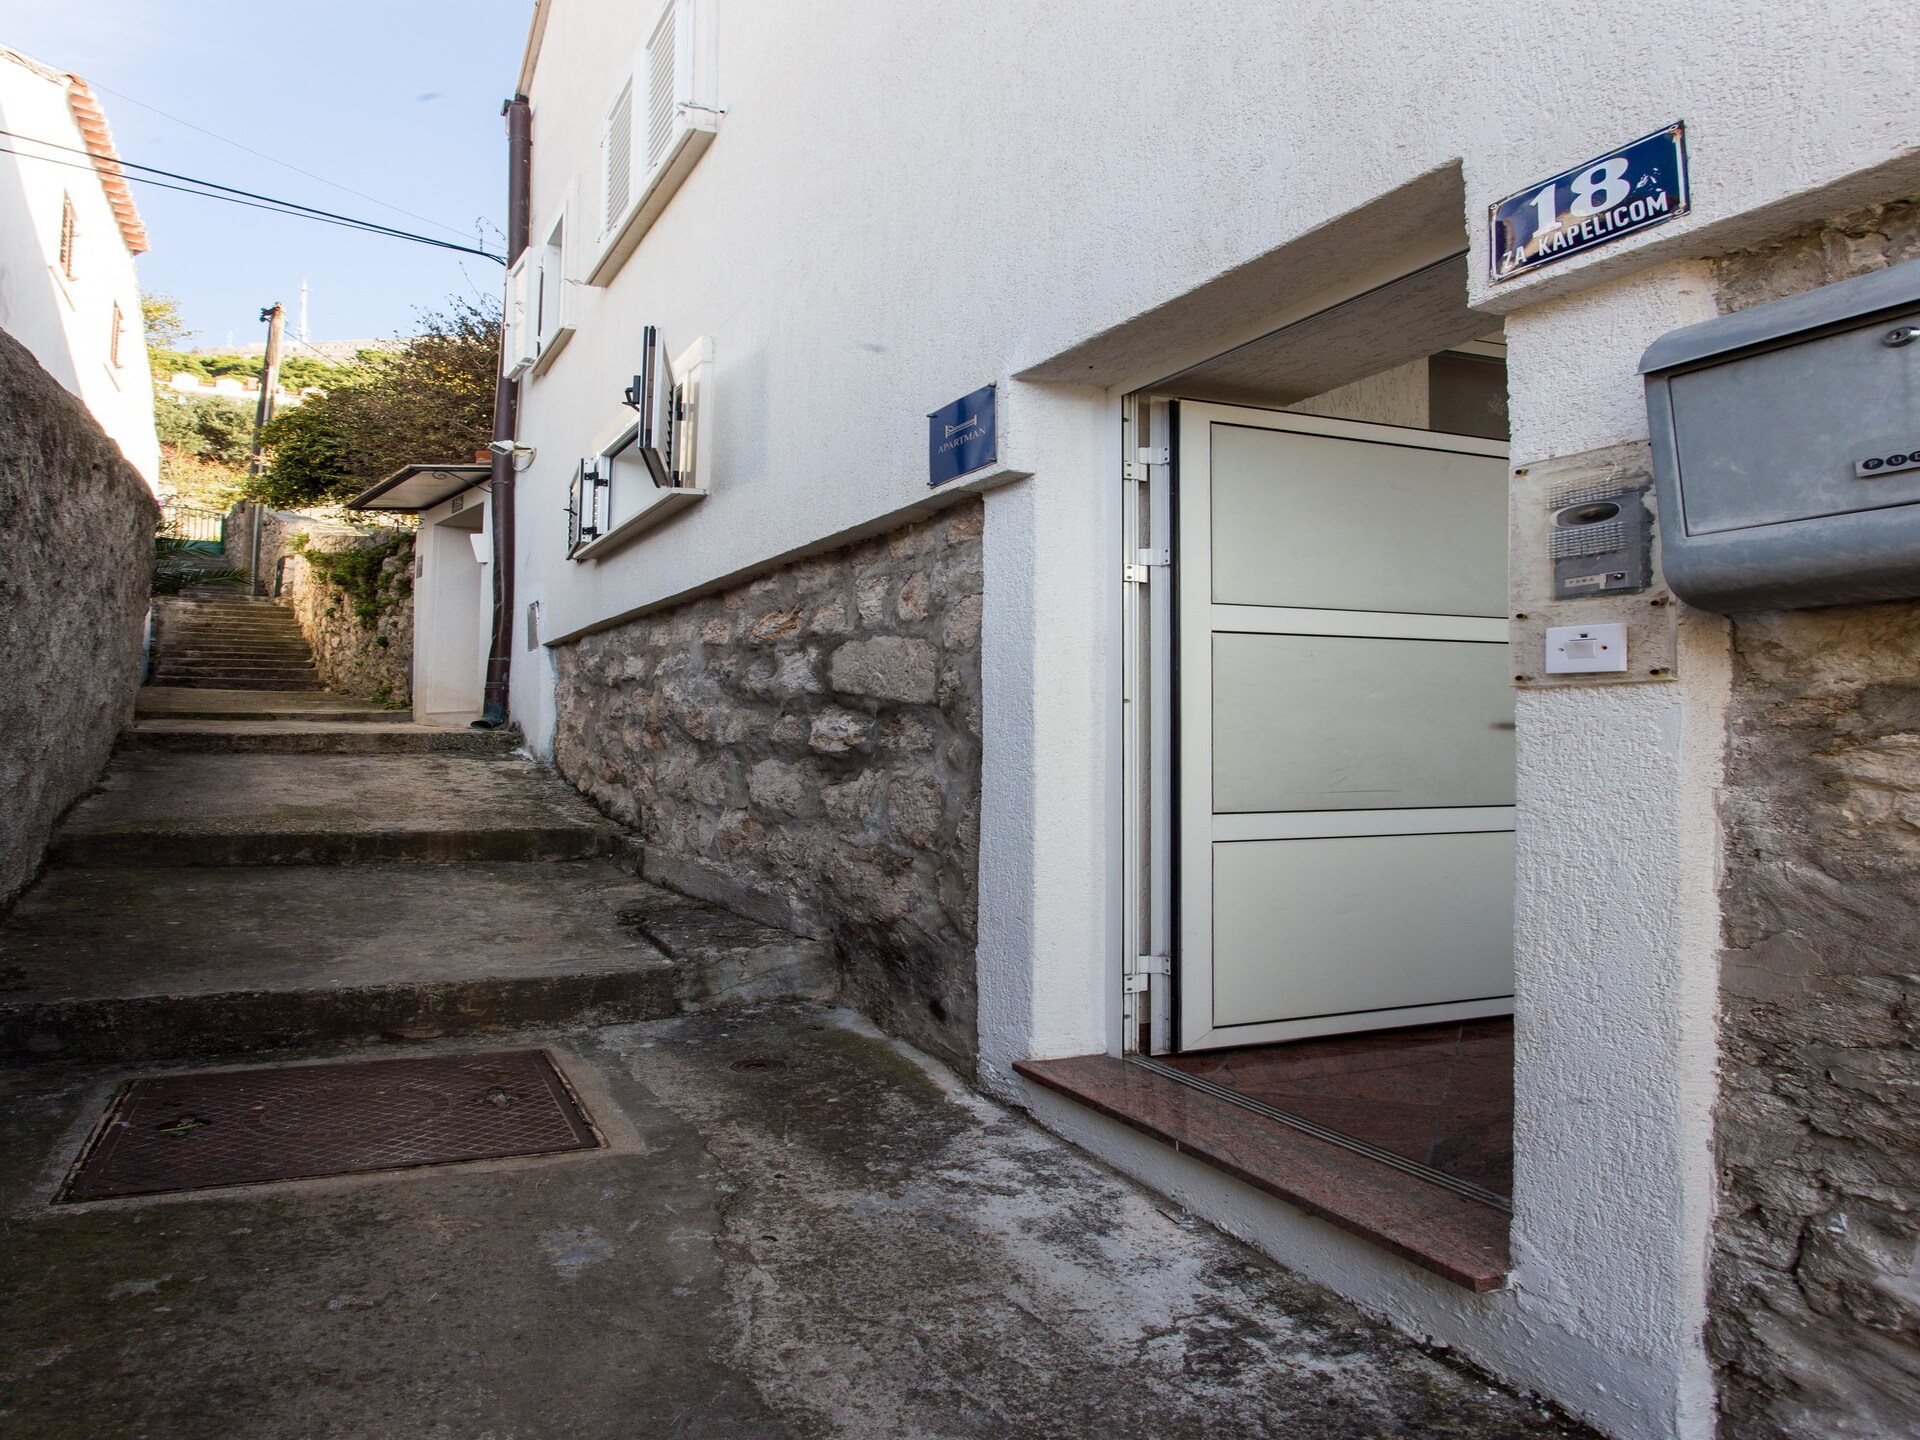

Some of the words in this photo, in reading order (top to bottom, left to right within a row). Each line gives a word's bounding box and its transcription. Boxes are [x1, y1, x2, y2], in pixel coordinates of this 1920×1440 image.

[1502, 246, 1527, 271] ZA
[1538, 191, 1669, 256] KAPELICOM
[1529, 157, 1630, 238] 18
[937, 426, 986, 454] APARTMAN
